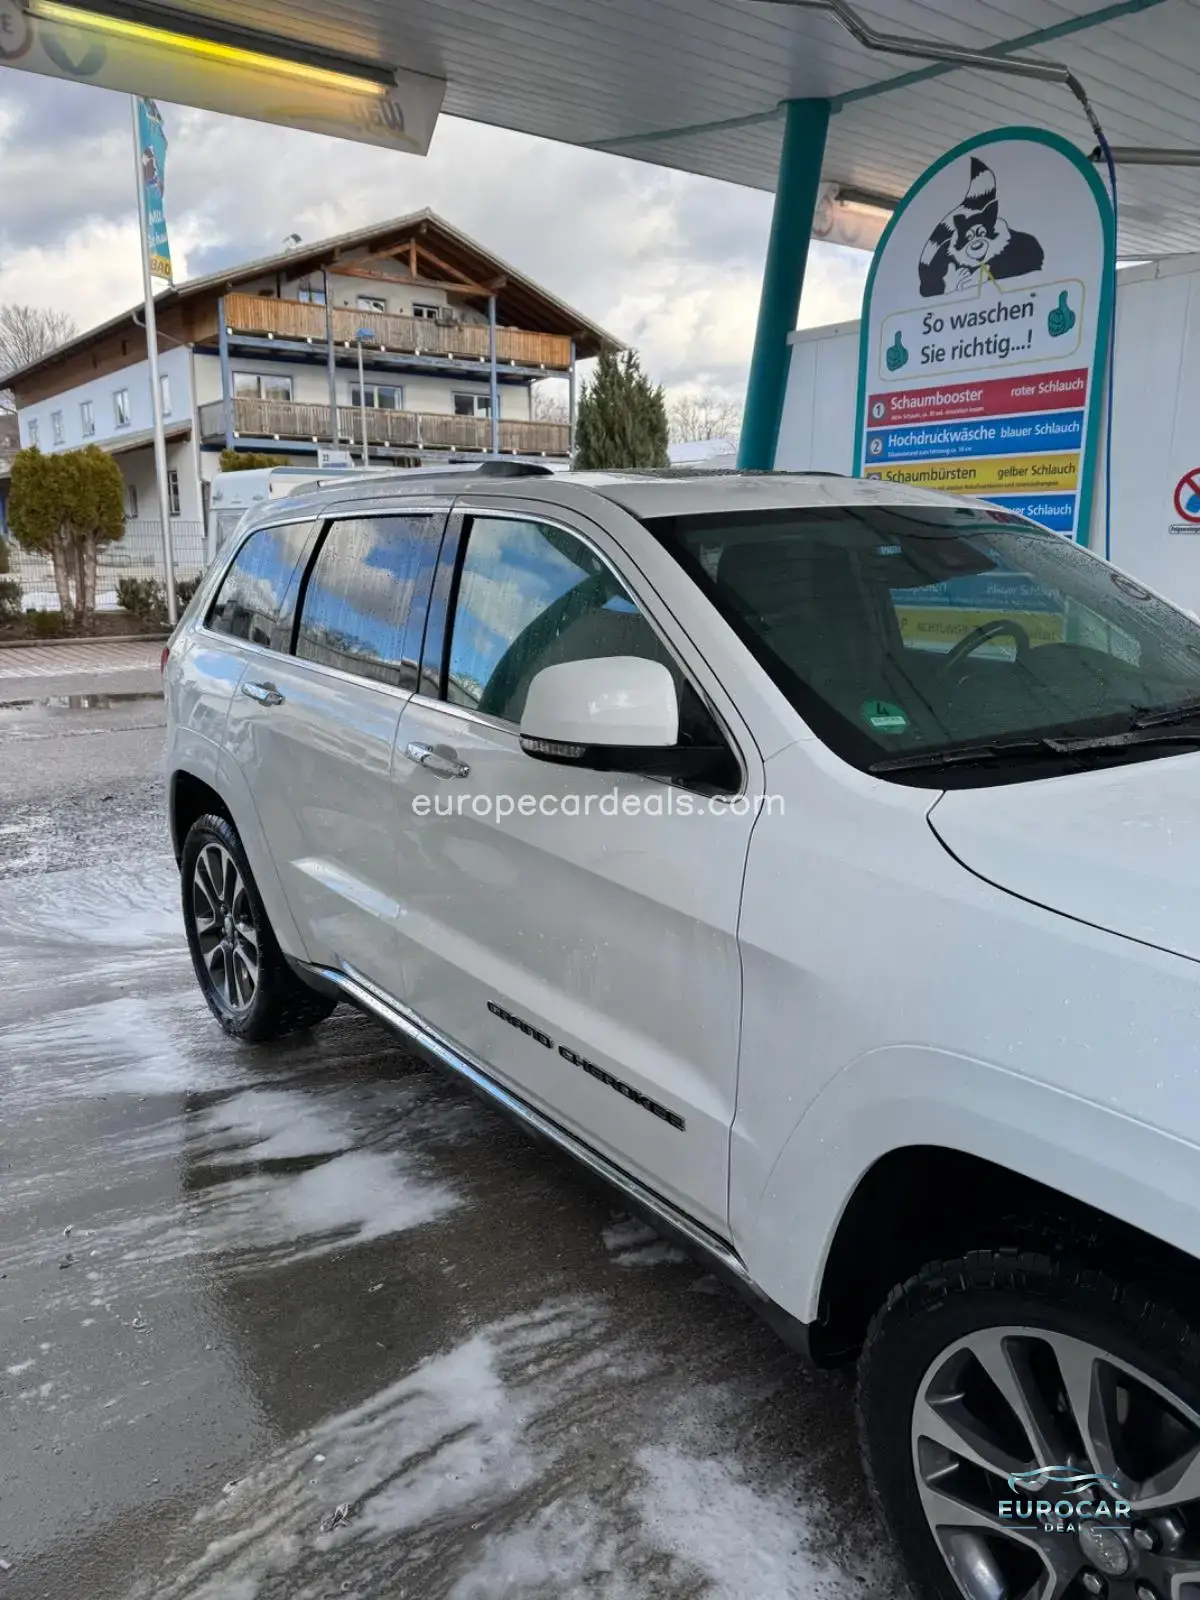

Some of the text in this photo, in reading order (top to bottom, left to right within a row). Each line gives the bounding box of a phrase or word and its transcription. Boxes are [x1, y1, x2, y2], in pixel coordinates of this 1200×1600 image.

[922, 302, 1034, 335] So waschen
[921, 329, 1032, 365] Sie richtig...!
[890, 389, 983, 411] Schaumbooster
[1011, 384, 1035, 397] roter
[1038, 378, 1084, 394] Schlauch
[888, 426, 996, 447] Hochdruckwäsche
[1000, 425, 1032, 439] blauer
[1034, 420, 1080, 436] Schlauch
[886, 463, 1076, 483] Schaumbürsten gelber Schlauch
[1028, 503, 1072, 516] Schlauch
